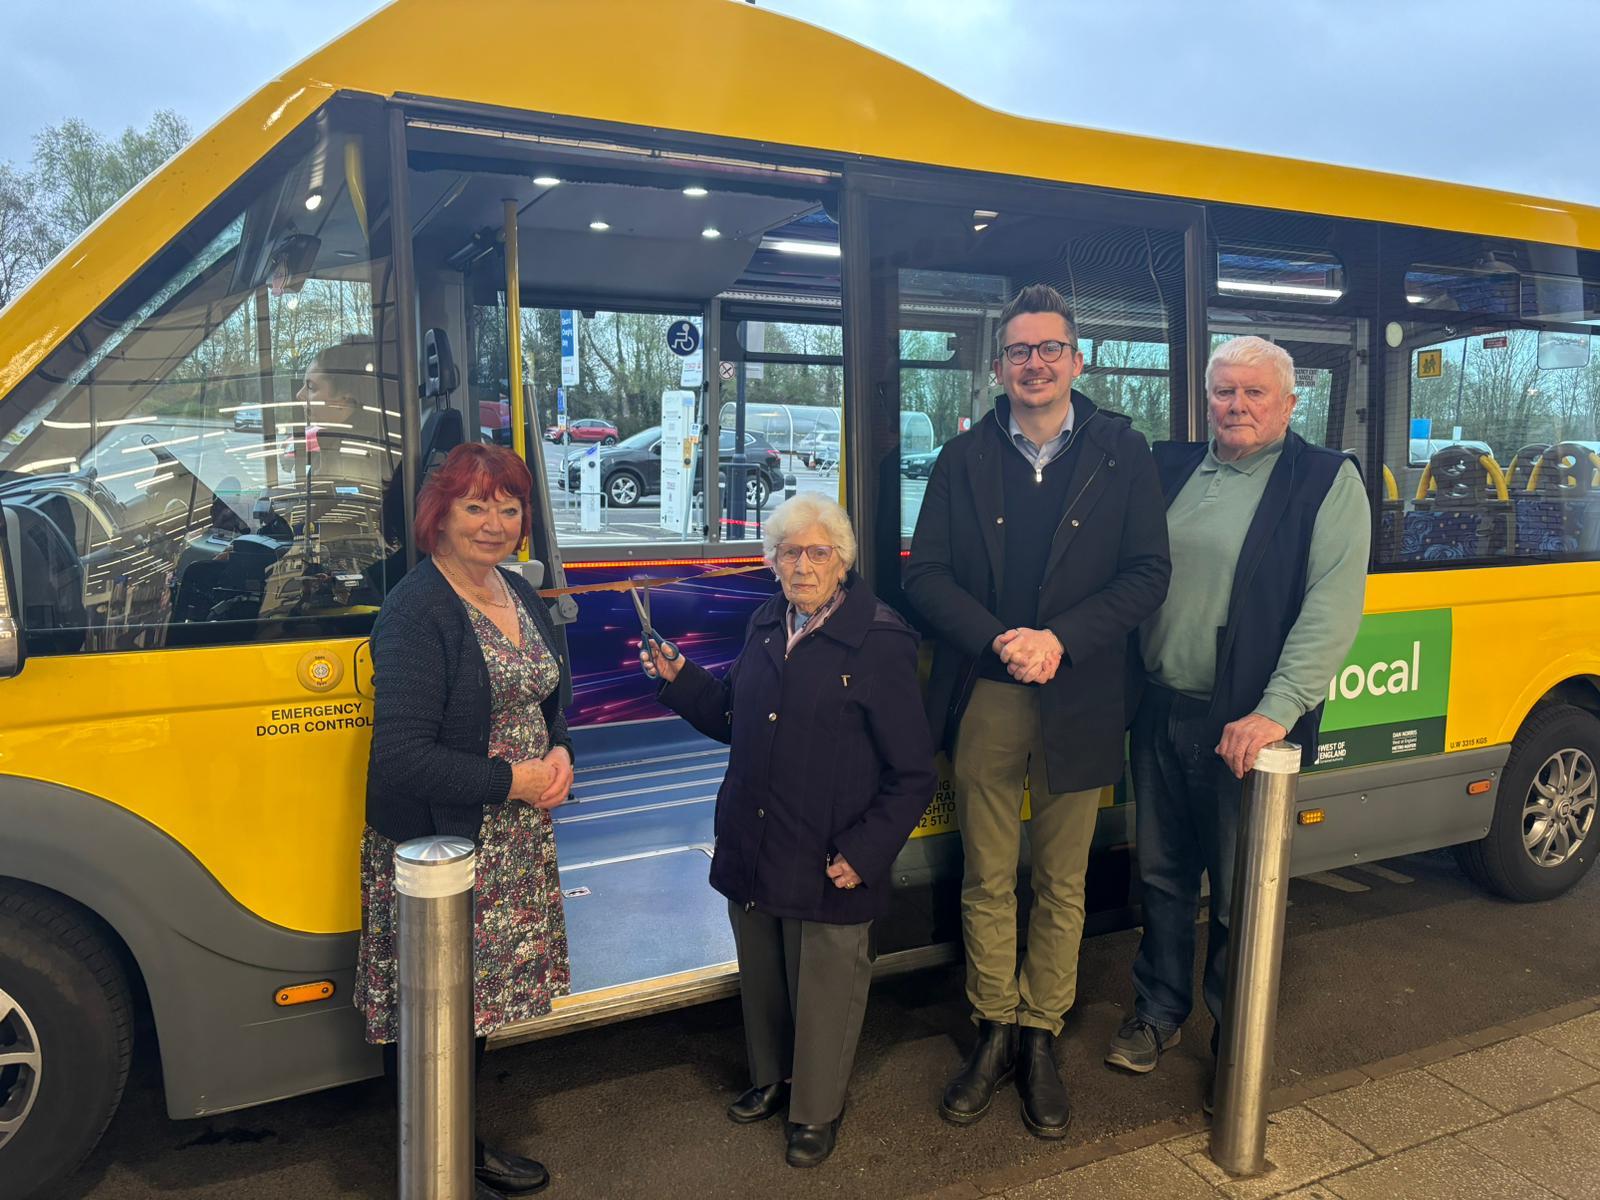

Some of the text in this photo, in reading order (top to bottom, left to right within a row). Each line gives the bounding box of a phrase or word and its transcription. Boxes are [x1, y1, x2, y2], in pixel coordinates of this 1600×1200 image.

[271, 702, 362, 721] EMERGENCY
[256, 716, 374, 737] DOOR CONTROL
[1320, 741, 1346, 752] WEST OF
[1320, 749, 1347, 760] ENGLAND
[924, 801, 956, 815] GHTO
[930, 814, 950, 826] 5TJ
